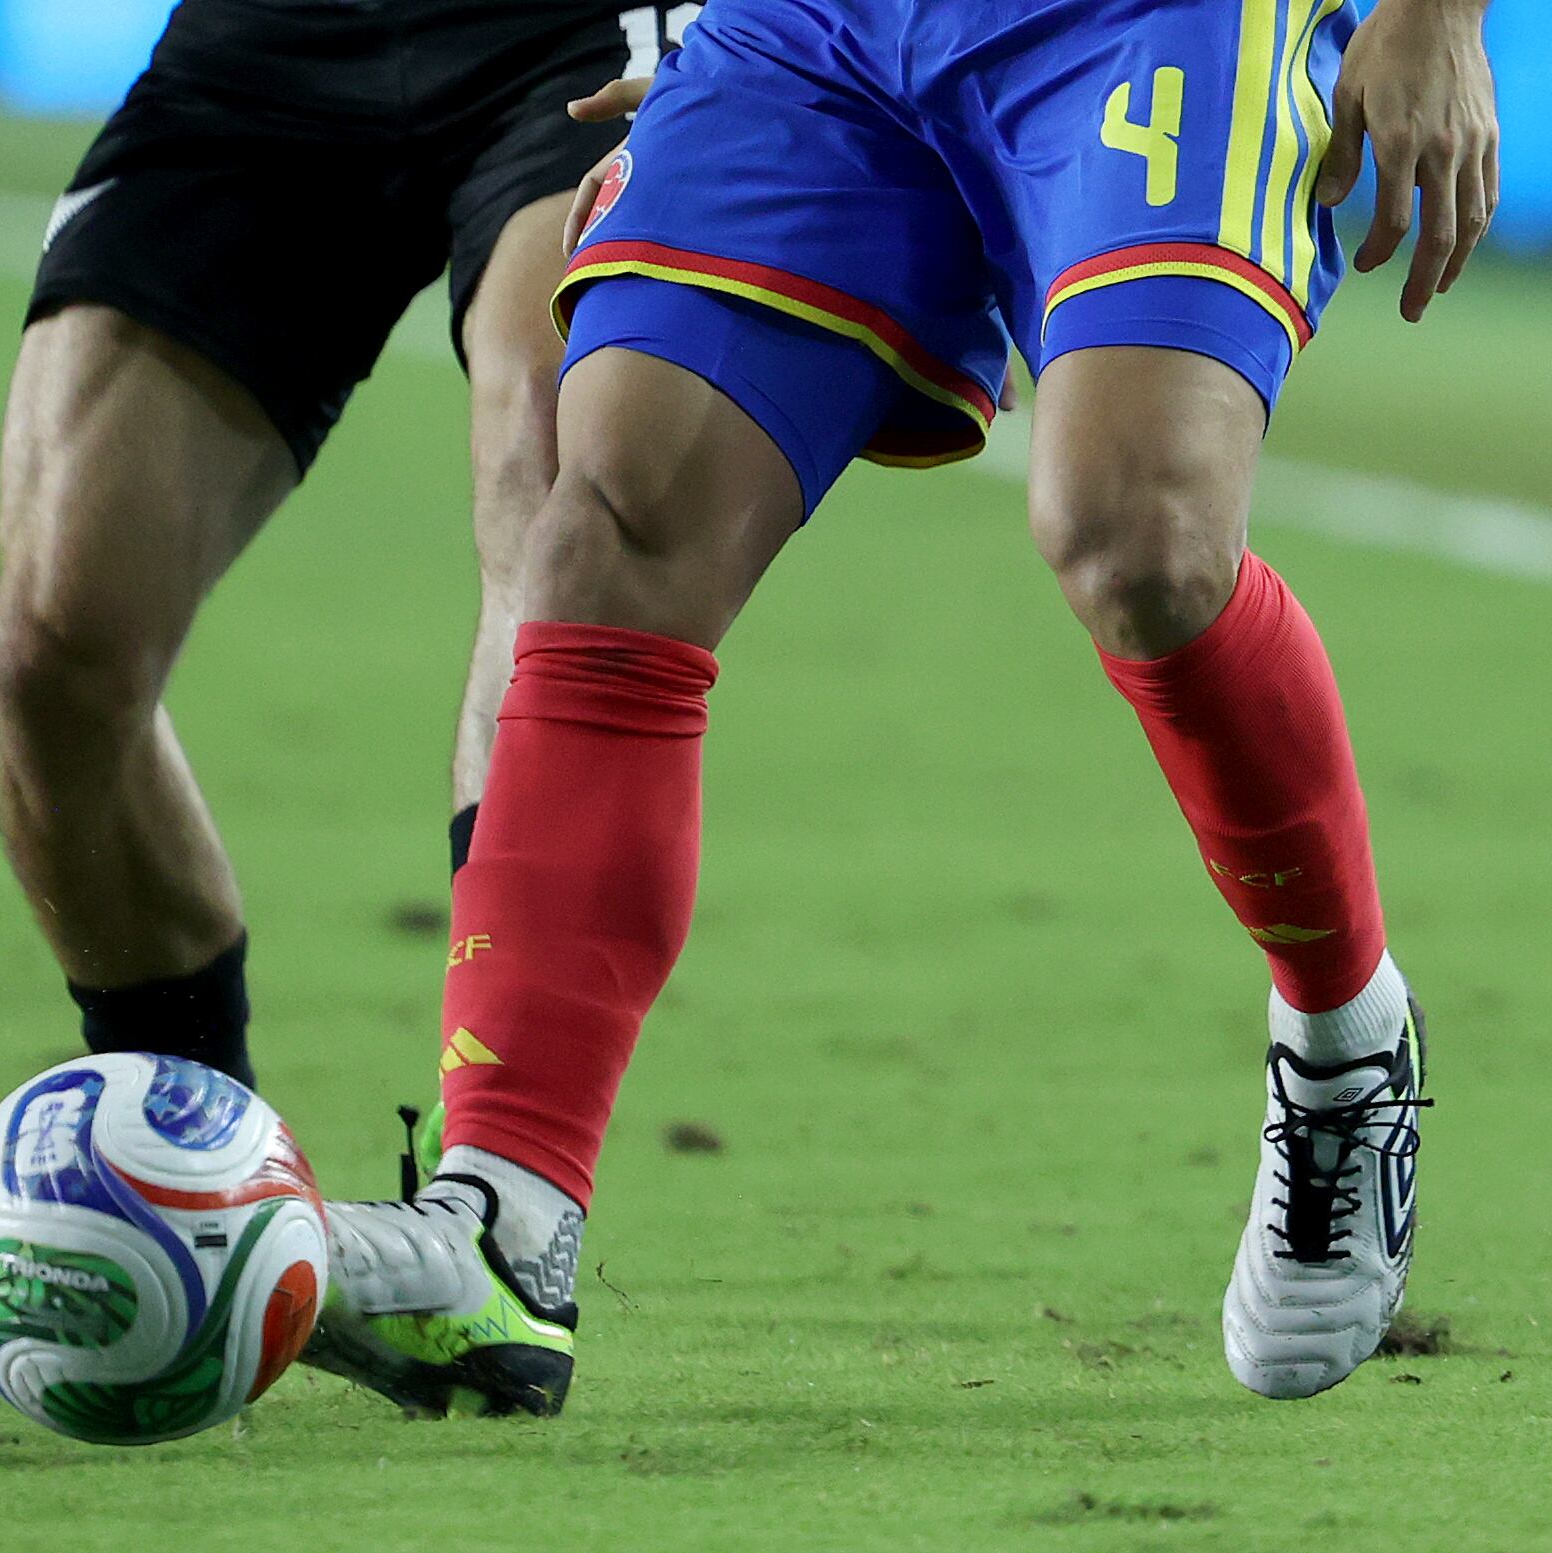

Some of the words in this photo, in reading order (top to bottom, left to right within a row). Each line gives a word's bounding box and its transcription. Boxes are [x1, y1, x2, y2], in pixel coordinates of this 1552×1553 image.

[618, 1, 704, 121] 1
[1100, 66, 1185, 207] 4
[0, 1252, 110, 1293] TRIONDA
